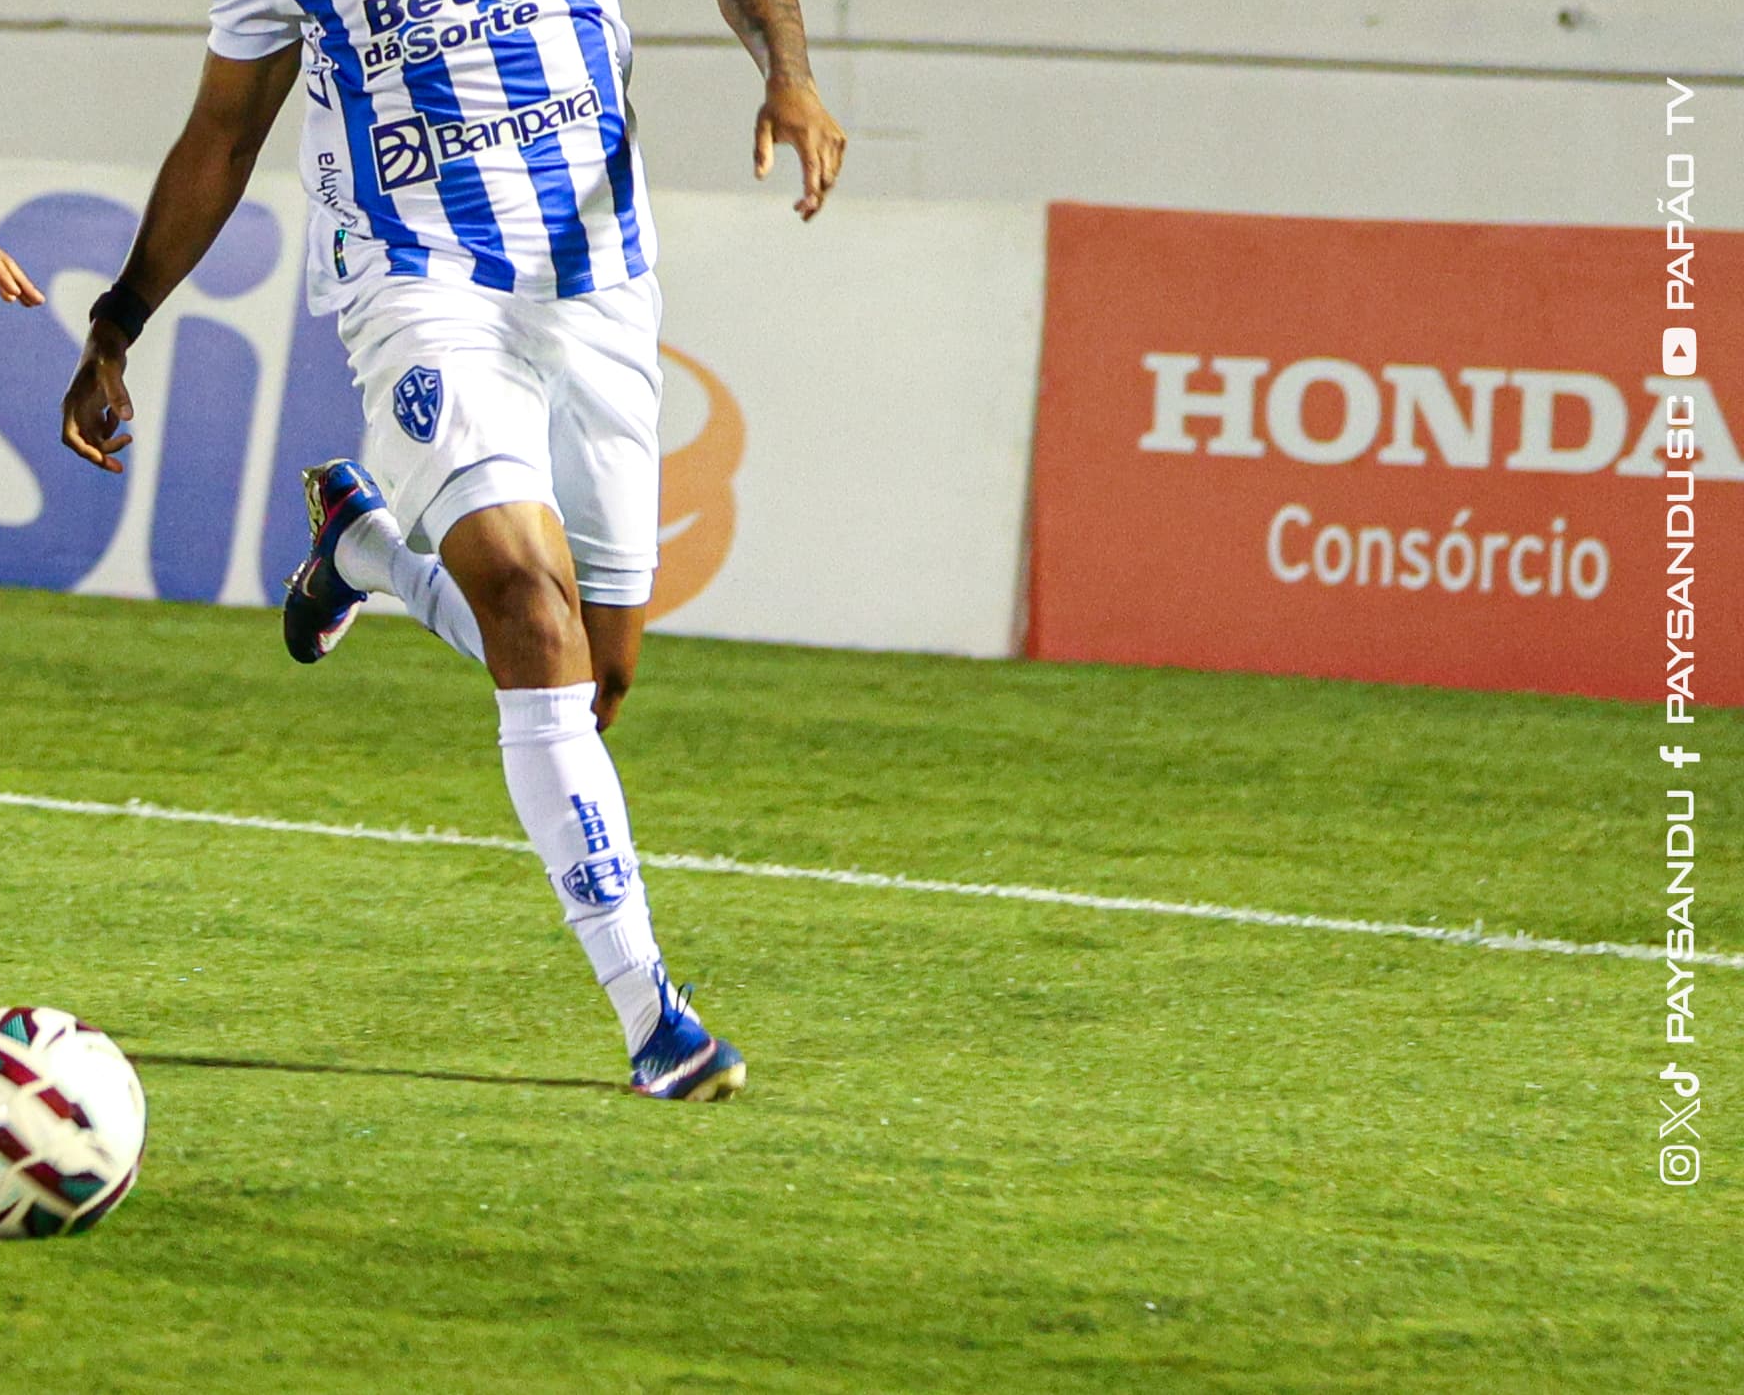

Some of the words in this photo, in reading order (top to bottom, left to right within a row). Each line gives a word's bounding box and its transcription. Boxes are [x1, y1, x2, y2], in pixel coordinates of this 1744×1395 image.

[406, 2, 540, 61] Sorte
[433, 78, 601, 161] Banpará
[1138, 351, 1744, 482] HONDA
[1266, 503, 1611, 602] Consórcio
